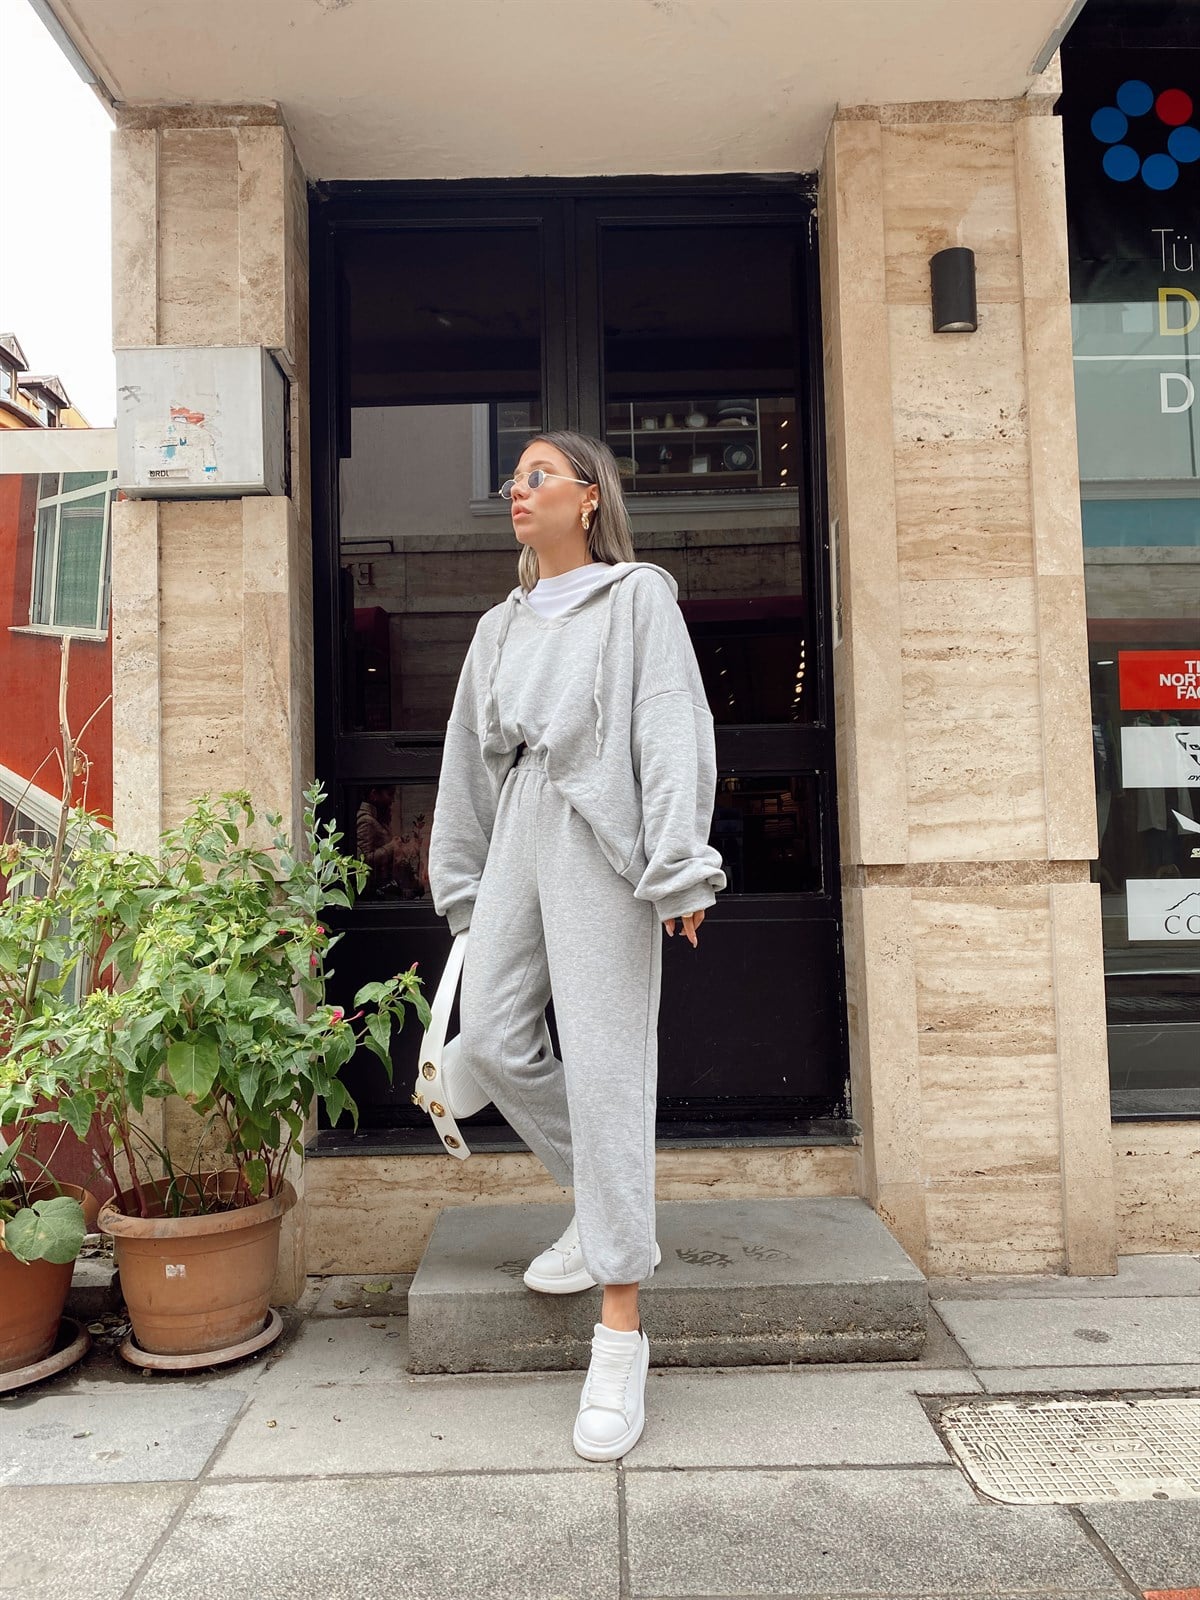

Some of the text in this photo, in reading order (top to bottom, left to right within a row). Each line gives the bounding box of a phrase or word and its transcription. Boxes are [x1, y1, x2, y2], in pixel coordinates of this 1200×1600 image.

[1151, 228, 1194, 272] Tü
[1158, 287, 1200, 336] D
[1160, 373, 1195, 413] D
